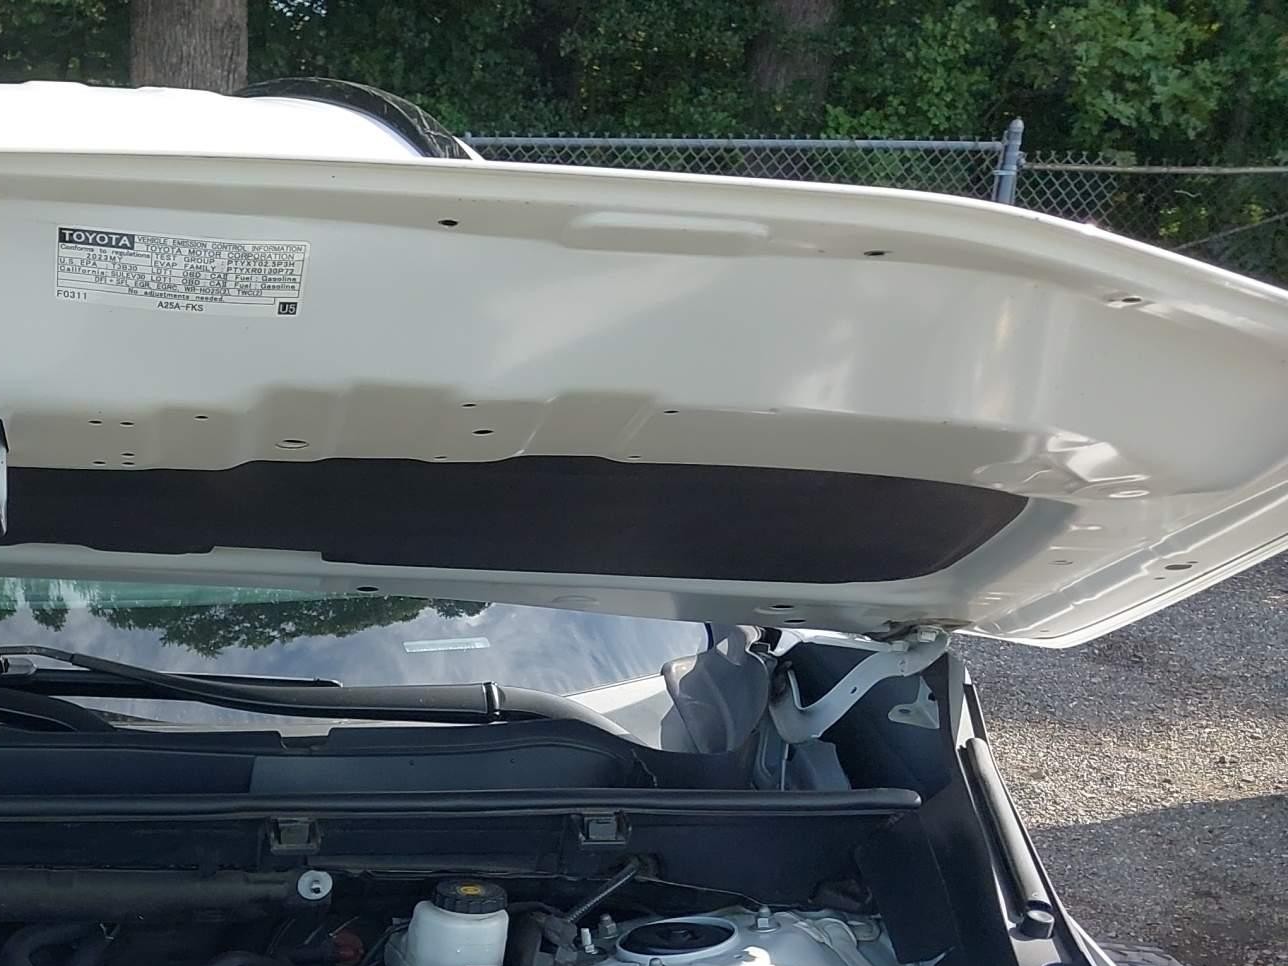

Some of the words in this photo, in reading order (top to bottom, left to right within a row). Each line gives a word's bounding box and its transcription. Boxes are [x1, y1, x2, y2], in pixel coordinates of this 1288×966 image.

[62, 230, 130, 247] TOYOTA
[137, 236, 168, 244] VEHICLE
[172, 240, 206, 248] EMISSION
[212, 242, 246, 252] CONTROL
[60, 244, 94, 252] Conforms
[112, 250, 150, 259] regulations
[146, 244, 183, 254] TOYOTA
[188, 249, 222, 258] MOTOR
[228, 252, 294, 261] CORPORATION
[80, 260, 98, 268] EPA
[155, 252, 176, 261] TEST
[184, 256, 214, 264] GROUP
[60, 265, 104, 275] California
[184, 263, 216, 272] FAMILY
[144, 291, 190, 300] adjustments
[157, 301, 204, 312] A25A-FKS
[279, 304, 296, 314] U5
